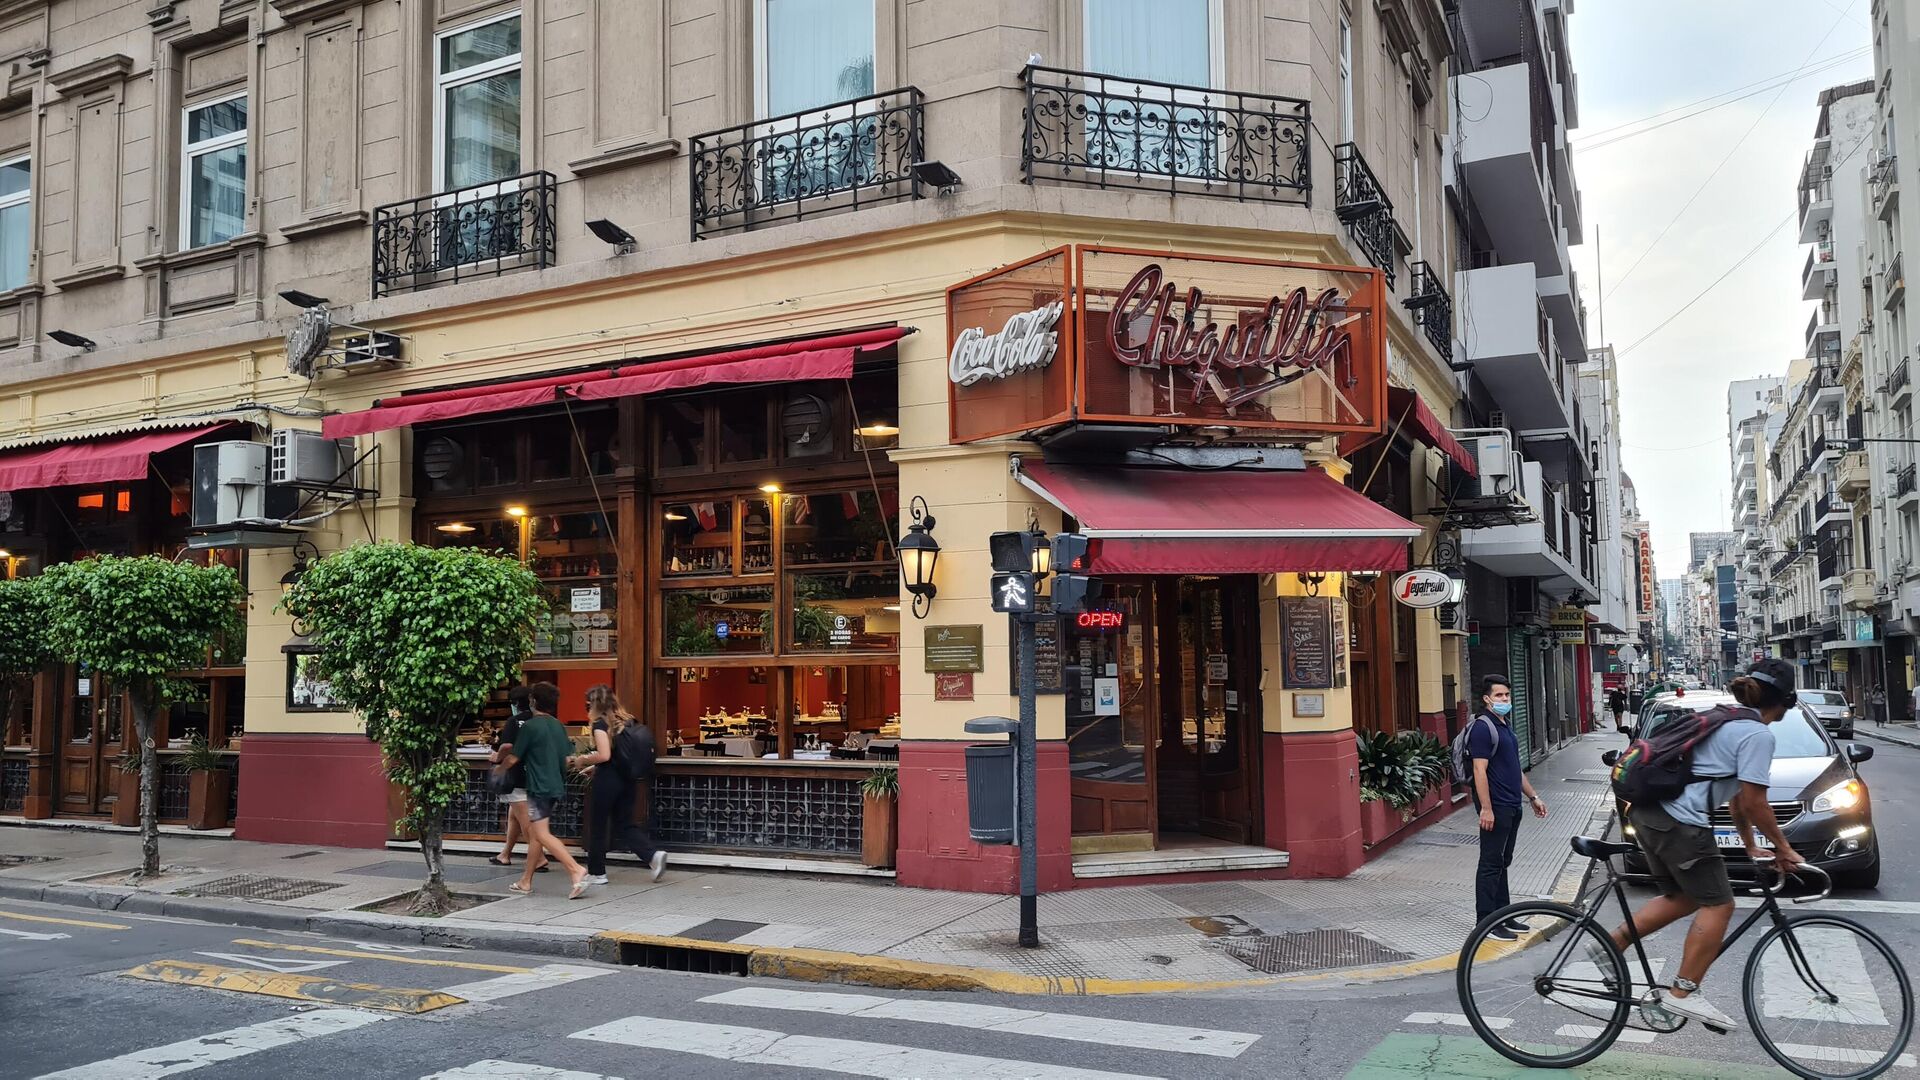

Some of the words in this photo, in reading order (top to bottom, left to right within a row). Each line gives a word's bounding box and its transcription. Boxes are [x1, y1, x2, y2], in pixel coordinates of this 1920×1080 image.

[949, 301, 1064, 386] Coca-Cola
[1401, 576, 1446, 598] Segafredo
[1079, 613, 1122, 626] OPEN
[1558, 611, 1583, 621] BRICK
[1717, 837, 1730, 846] AA
